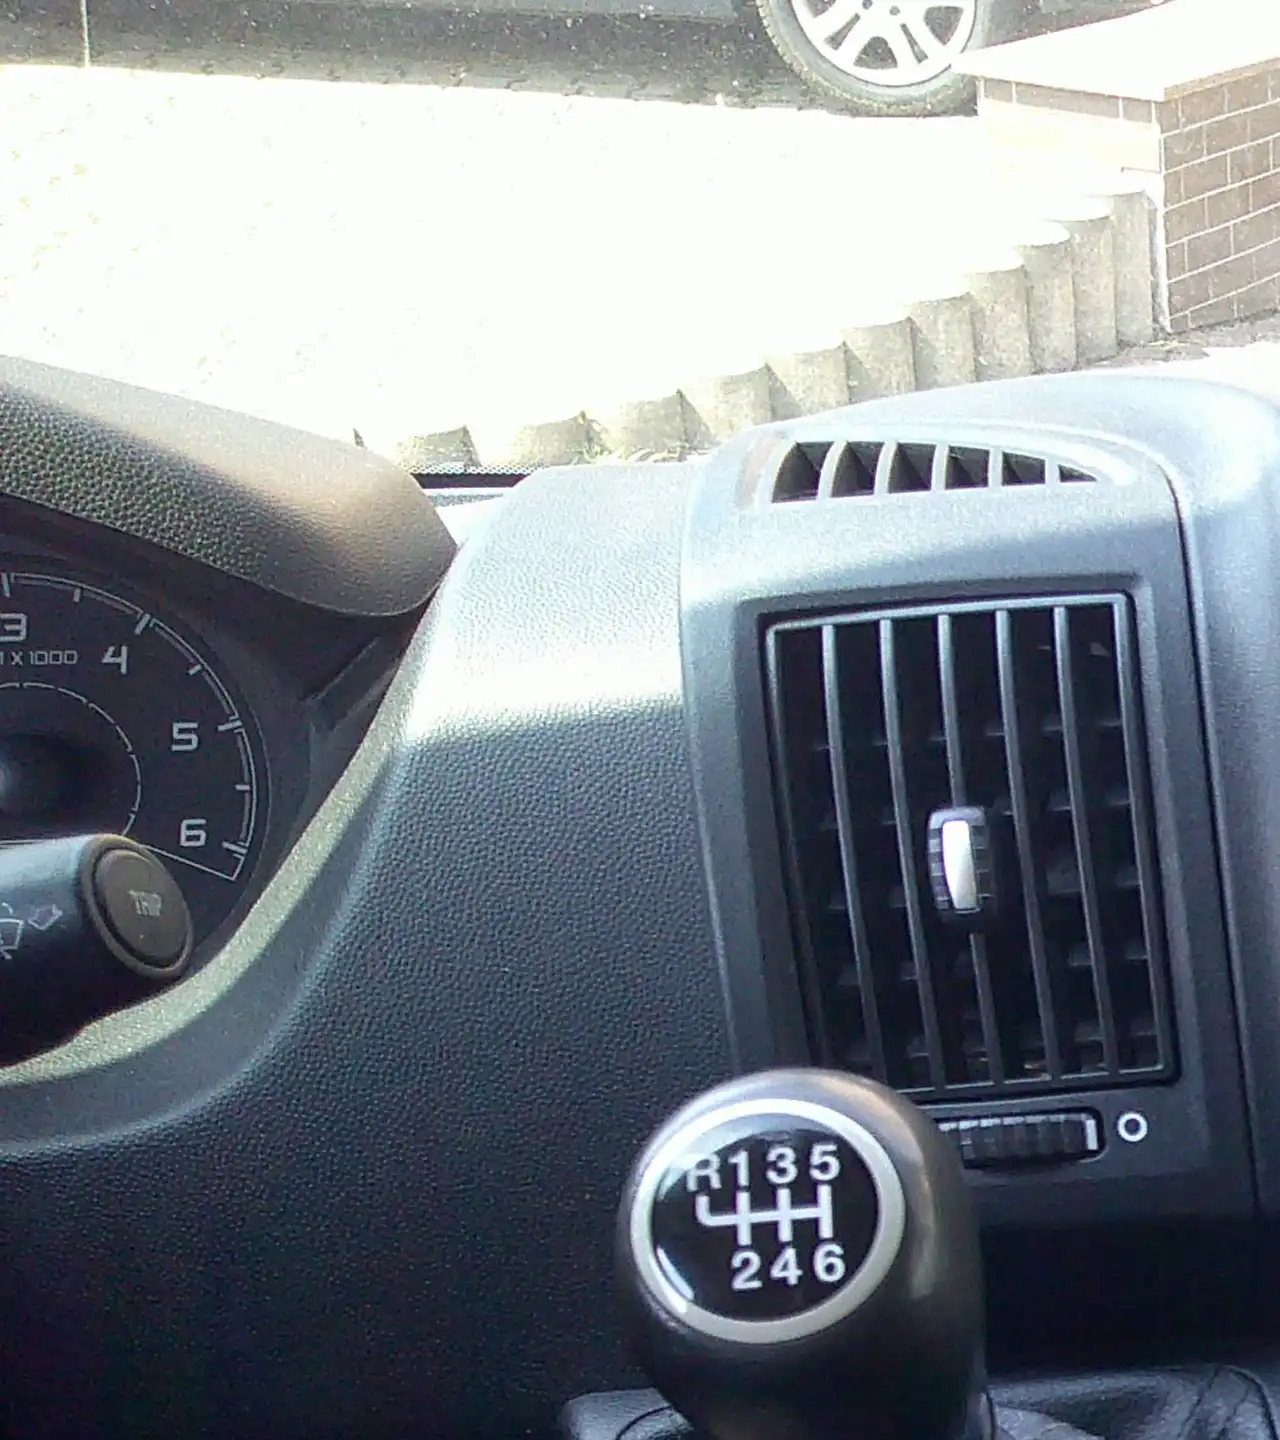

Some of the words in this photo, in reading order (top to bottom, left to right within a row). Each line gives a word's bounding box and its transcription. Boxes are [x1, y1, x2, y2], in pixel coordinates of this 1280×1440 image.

[0, 612, 27, 642] 3
[30, 650, 78, 665] 1000
[101, 645, 128, 674] 4
[172, 722, 198, 752] 5
[181, 819, 206, 847] 6
[687, 1153, 721, 1192] R
[729, 1151, 750, 1186] 1
[766, 1147, 797, 1184] 3
[809, 1144, 841, 1181] 5
[731, 1251, 763, 1291] 2
[770, 1246, 803, 1285] 4
[813, 1243, 846, 1283] 6
